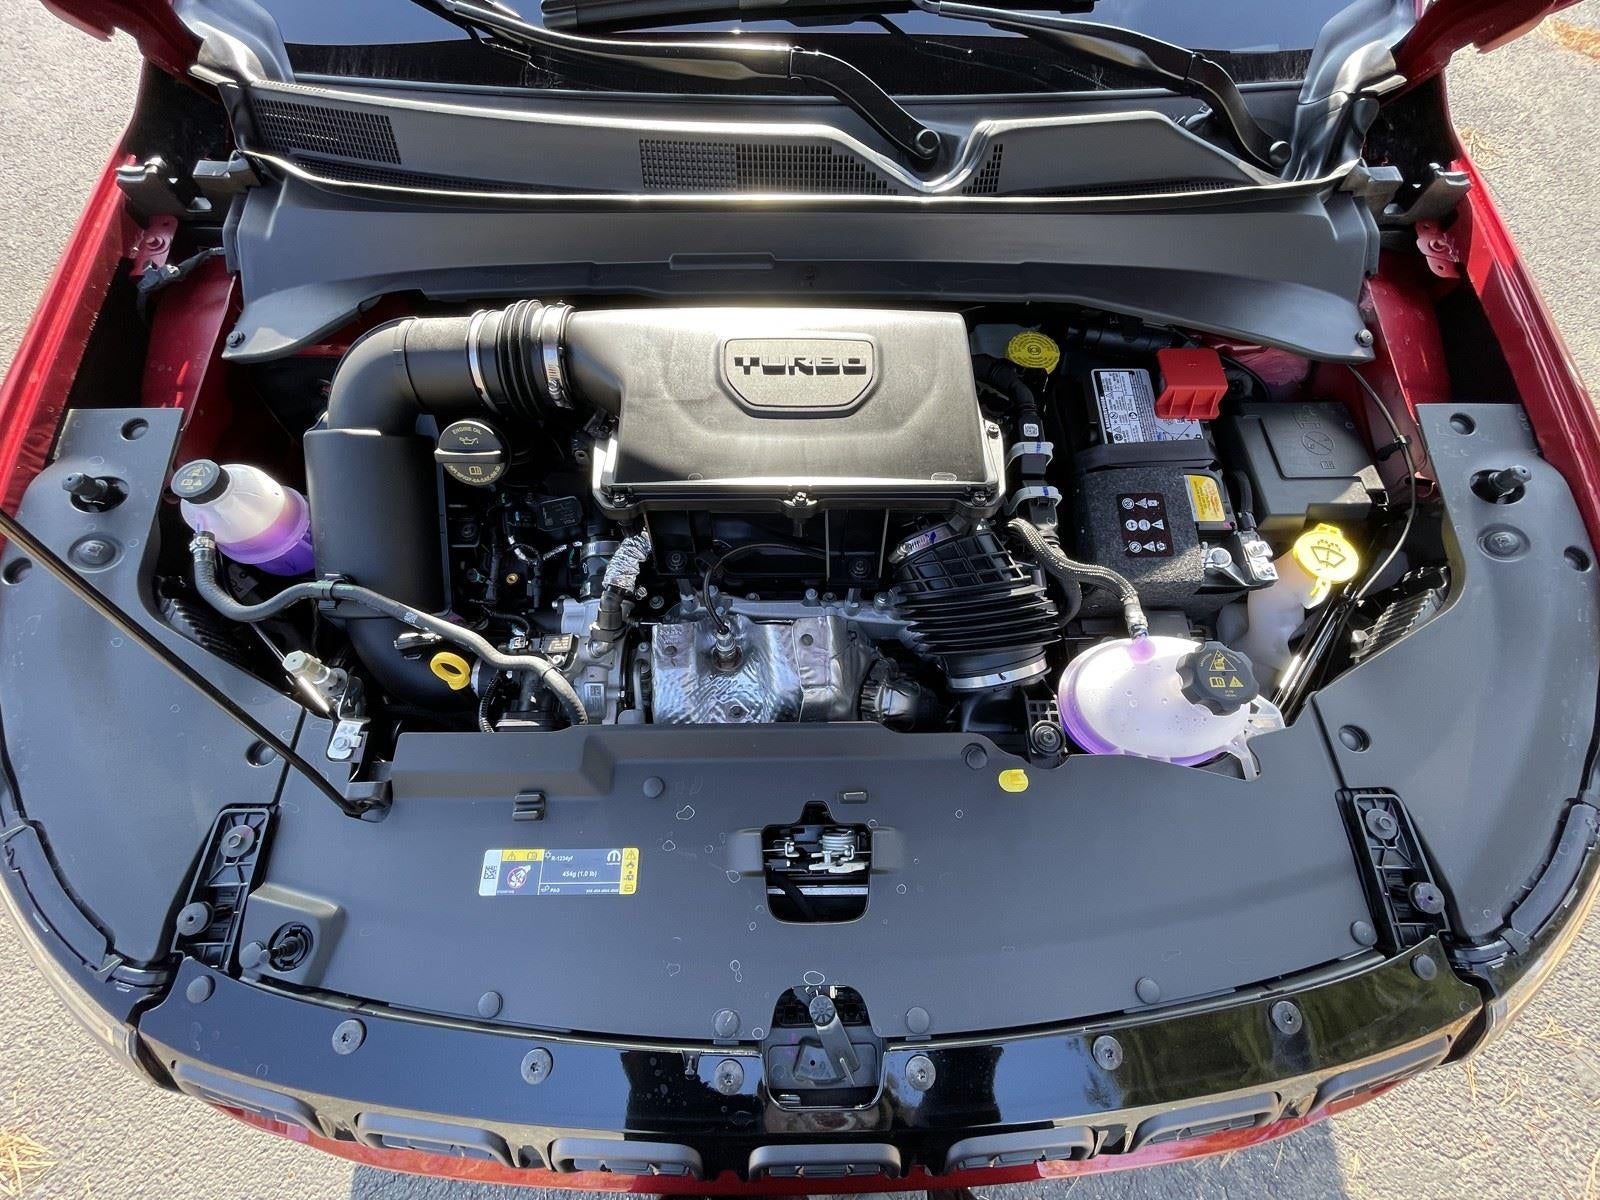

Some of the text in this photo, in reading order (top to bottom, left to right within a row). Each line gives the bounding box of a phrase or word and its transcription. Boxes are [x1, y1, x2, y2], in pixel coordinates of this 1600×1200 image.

[733, 356, 867, 376] TURBO
[452, 426, 482, 435] ENGINE OIL
[562, 870, 577, 878] 454g
